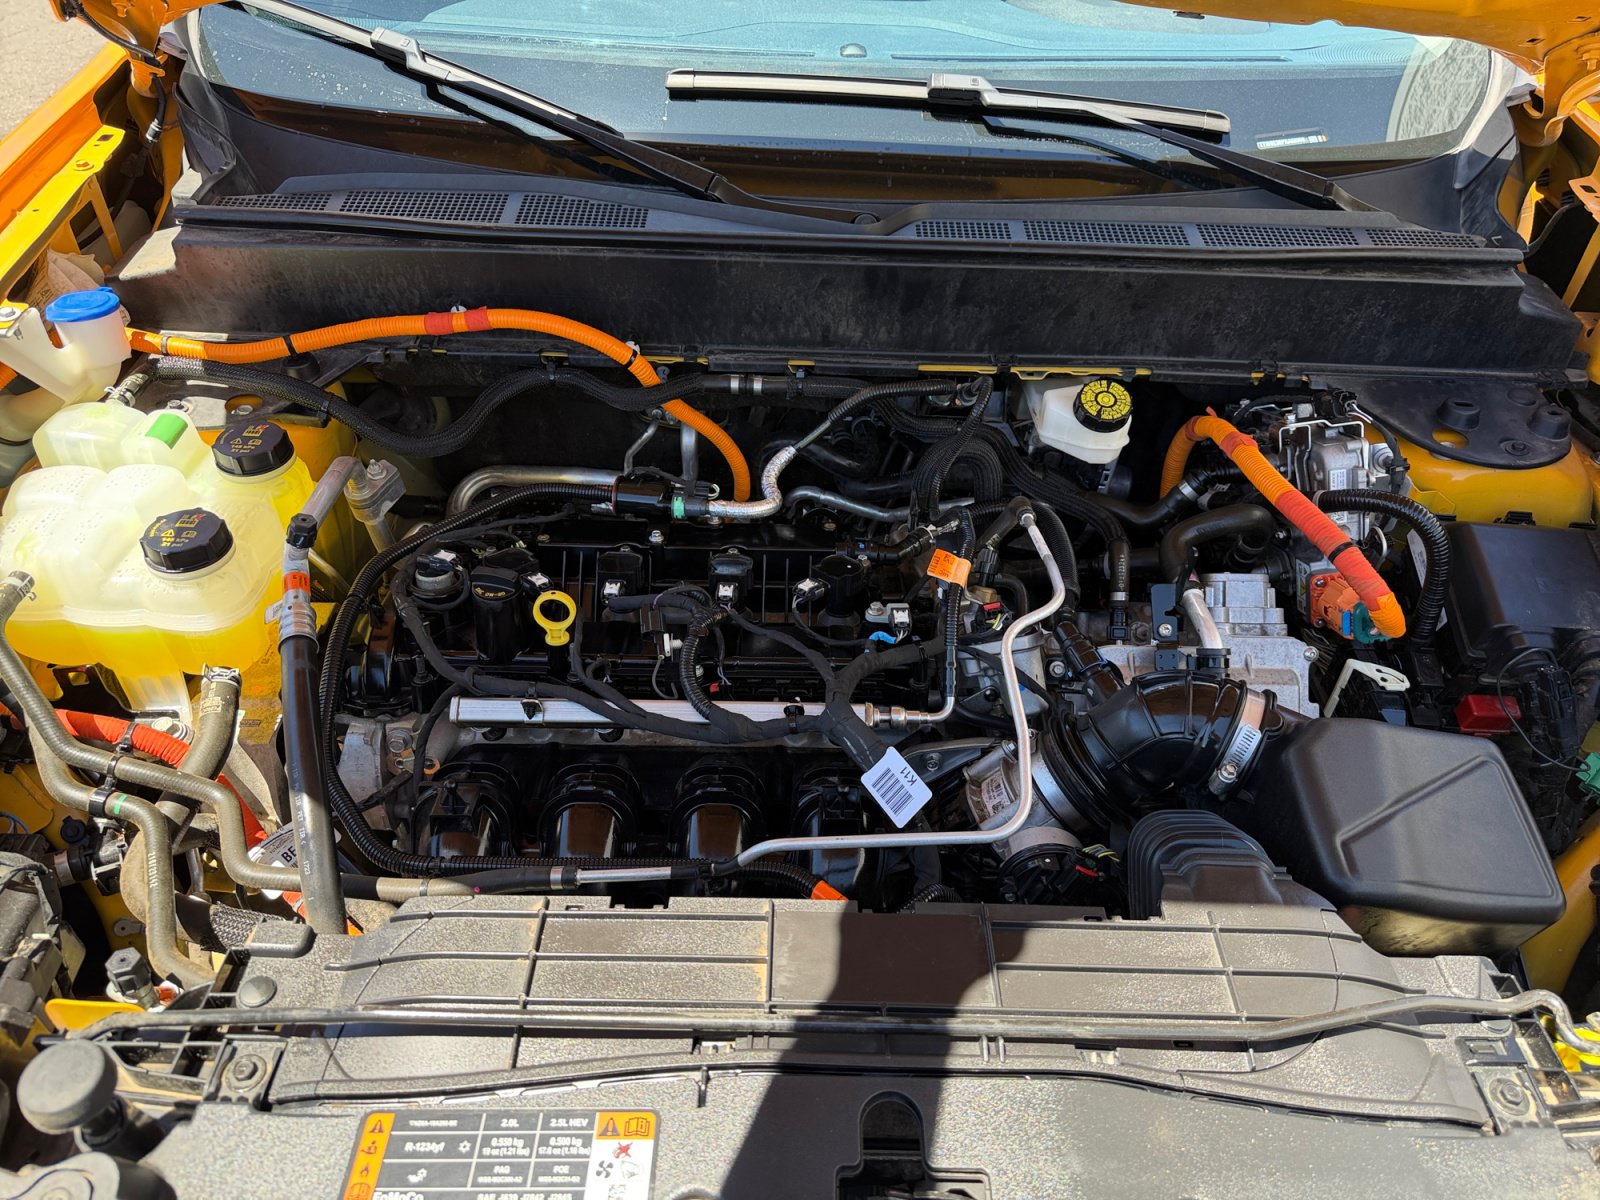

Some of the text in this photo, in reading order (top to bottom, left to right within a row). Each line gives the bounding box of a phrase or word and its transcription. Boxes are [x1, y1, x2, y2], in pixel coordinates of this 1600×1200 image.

[900, 766, 918, 786] K11
[500, 1118, 520, 1127] 2.0L
[549, 1118, 568, 1127] 2.5L
[569, 1118, 589, 1127] HEV
[404, 1136, 583, 1154] R-1234yf 0.550 kg 0.500 kg
[491, 1148, 500, 1156] oz
[500, 1147, 516, 1157] (1.21
[517, 1147, 530, 1157] lbs)
[578, 1147, 592, 1156] lbs)
[493, 1165, 570, 1174] PAG POE
[372, 1191, 425, 1200] FoMoCo
